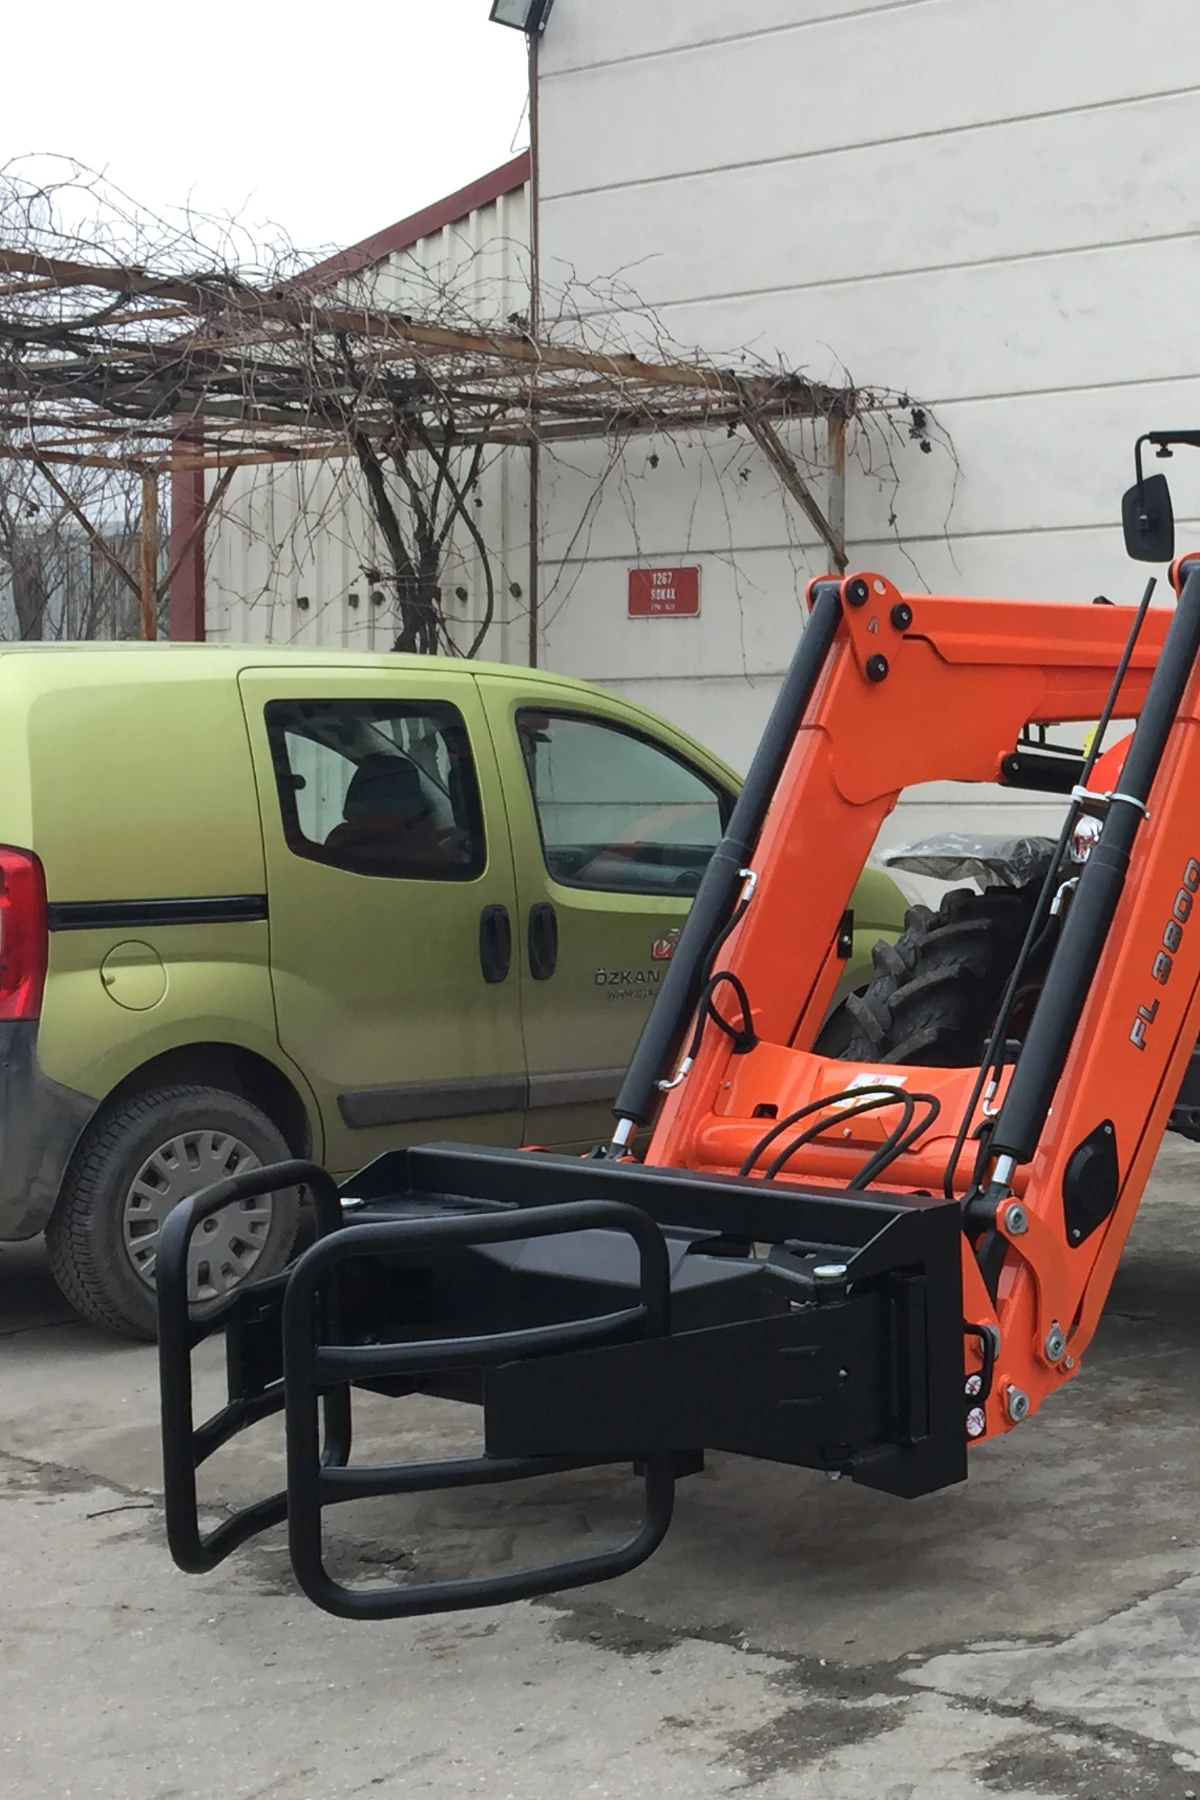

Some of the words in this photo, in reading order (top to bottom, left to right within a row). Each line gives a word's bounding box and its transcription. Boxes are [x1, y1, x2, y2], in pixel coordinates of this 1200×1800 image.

[652, 572, 673, 586] 1267
[595, 967, 661, 985] ÖZKAN
[1129, 998, 1160, 1051] FL
